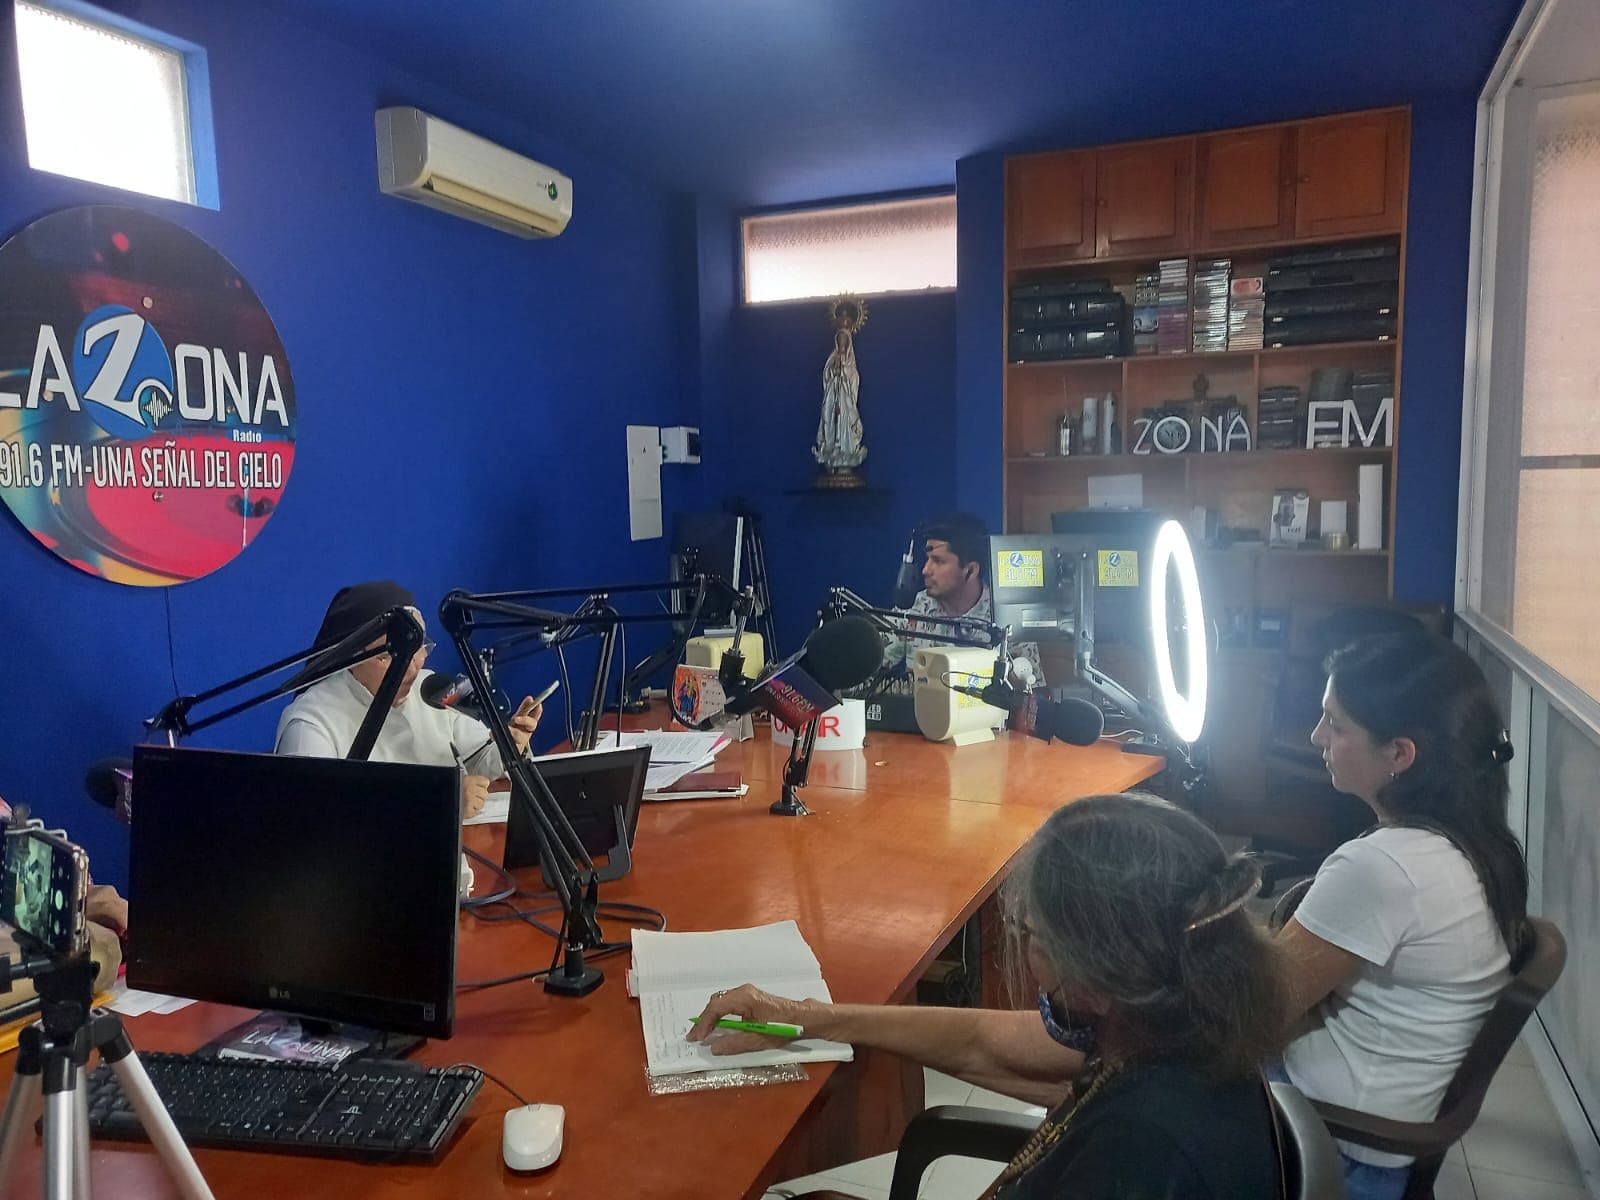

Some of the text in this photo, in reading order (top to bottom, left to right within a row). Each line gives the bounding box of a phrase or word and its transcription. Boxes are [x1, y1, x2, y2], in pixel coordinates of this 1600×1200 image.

[232, 429, 262, 443] Radio
[1132, 398, 1394, 454] ZONA FM
[0, 442, 44, 488] 91.6
[140, 440, 201, 488] SEÑAL
[204, 450, 236, 488] DEL
[238, 452, 282, 488] CIELO
